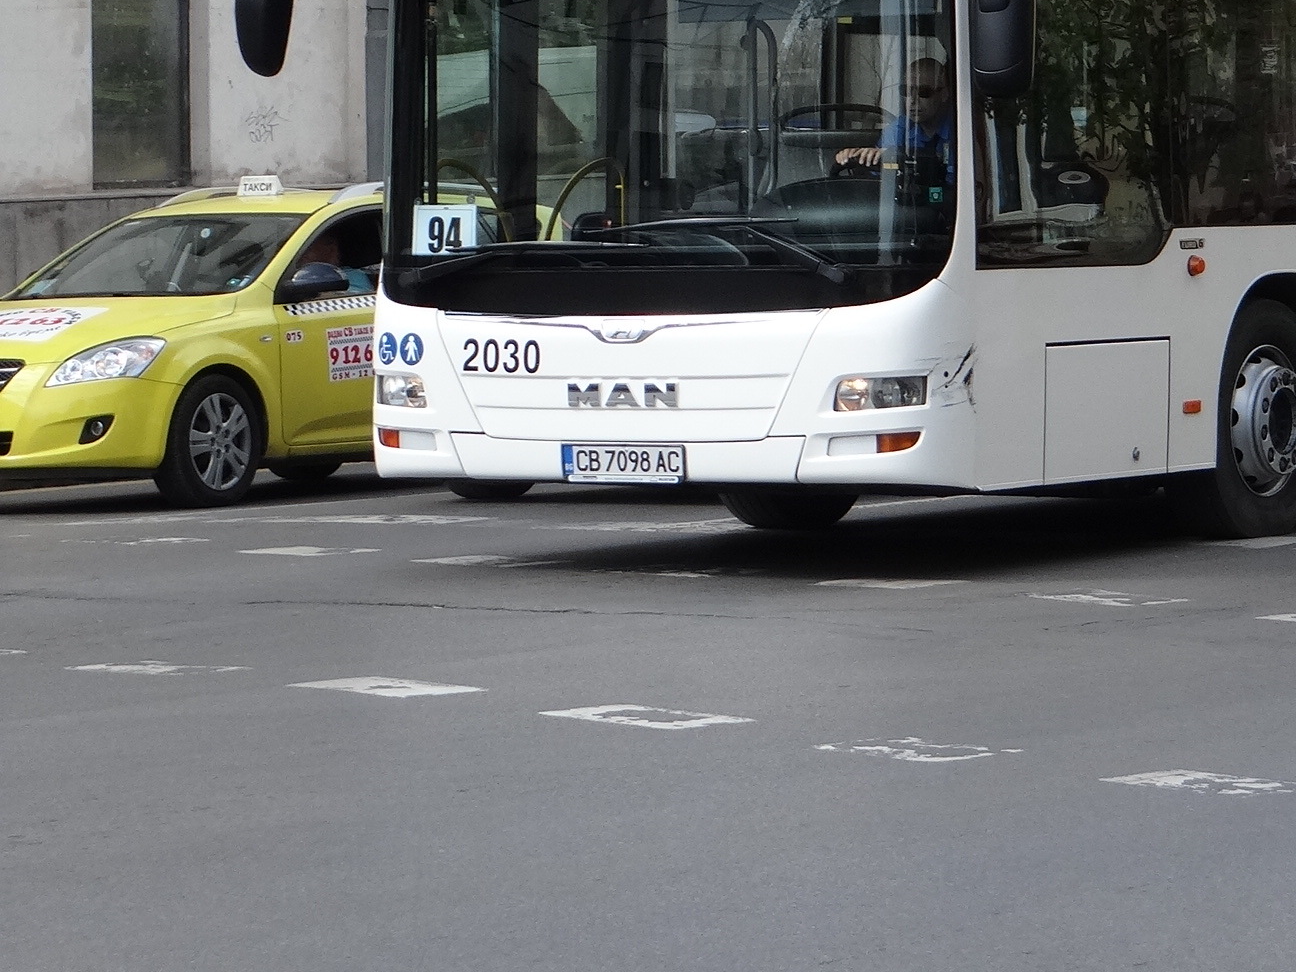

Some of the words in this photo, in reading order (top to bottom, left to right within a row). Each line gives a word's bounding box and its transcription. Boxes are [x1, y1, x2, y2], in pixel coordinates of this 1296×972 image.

[243, 183, 273, 192] ТАКСИ
[428, 216, 462, 253] 94
[463, 338, 541, 374] 2030
[567, 382, 679, 408] MAN
[604, 449, 651, 473] 7098
